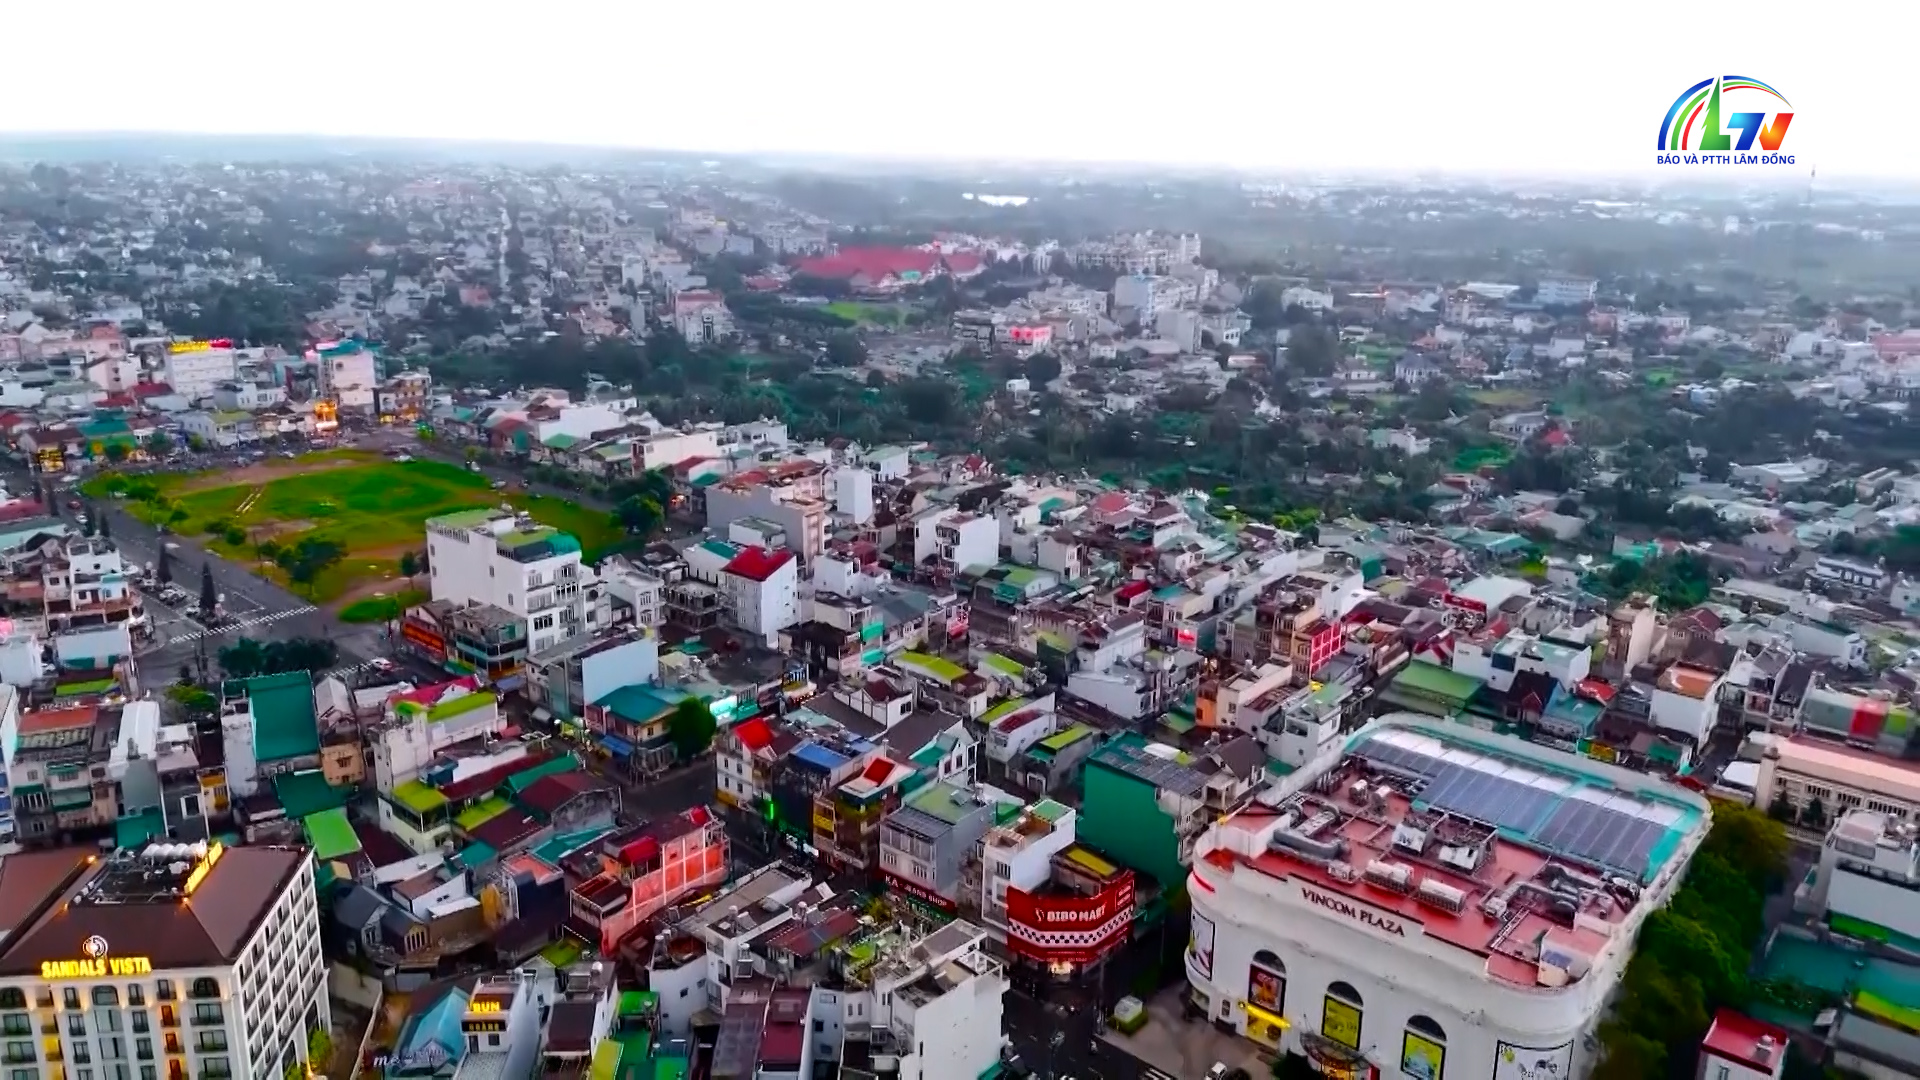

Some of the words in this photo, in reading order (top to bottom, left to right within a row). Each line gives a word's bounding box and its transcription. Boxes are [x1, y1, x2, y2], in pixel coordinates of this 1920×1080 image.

[1079, 901, 1108, 922] MART
[1302, 887, 1357, 919] VINCOM
[1360, 909, 1405, 938] PLAZA
[41, 959, 106, 978] SANDALS
[109, 957, 152, 975] VISTA
